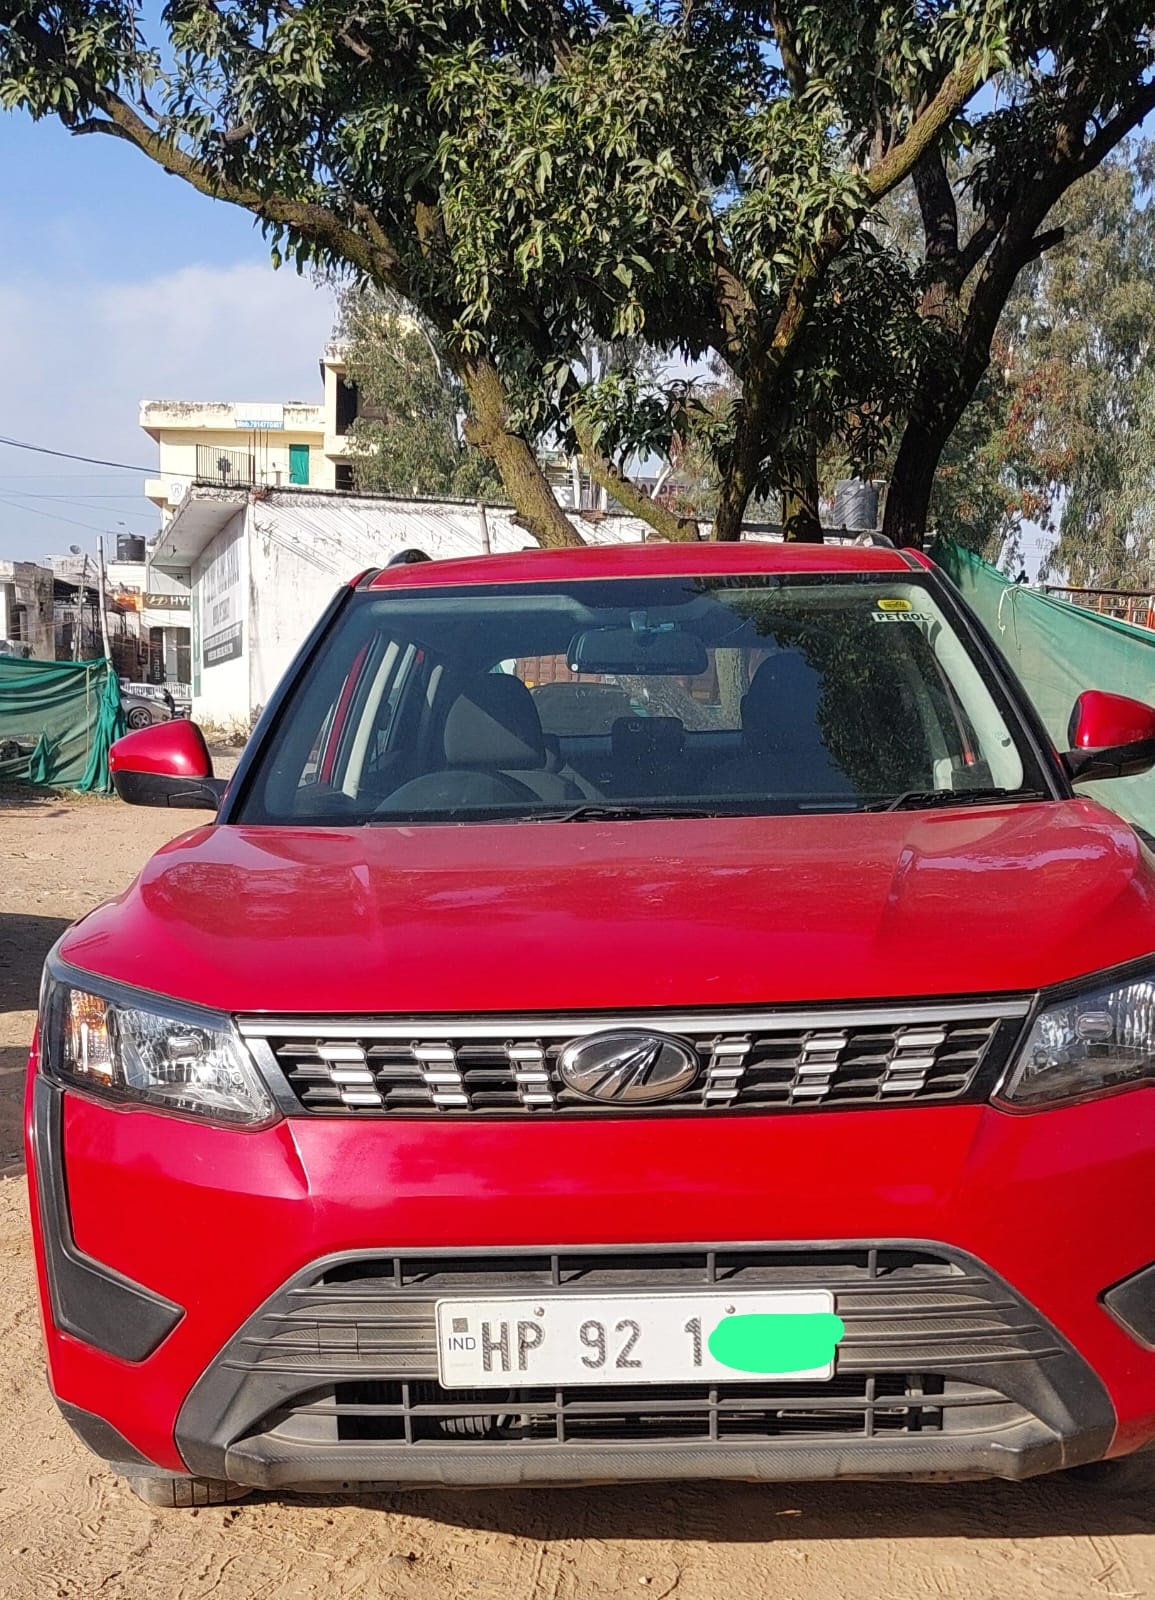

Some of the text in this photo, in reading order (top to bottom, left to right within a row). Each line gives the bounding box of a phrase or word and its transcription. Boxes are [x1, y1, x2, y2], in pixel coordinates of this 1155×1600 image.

[876, 613, 929, 621] PETROL
[448, 1337, 476, 1350] IND
[481, 1321, 545, 1371] HP
[579, 1319, 642, 1369] 92
